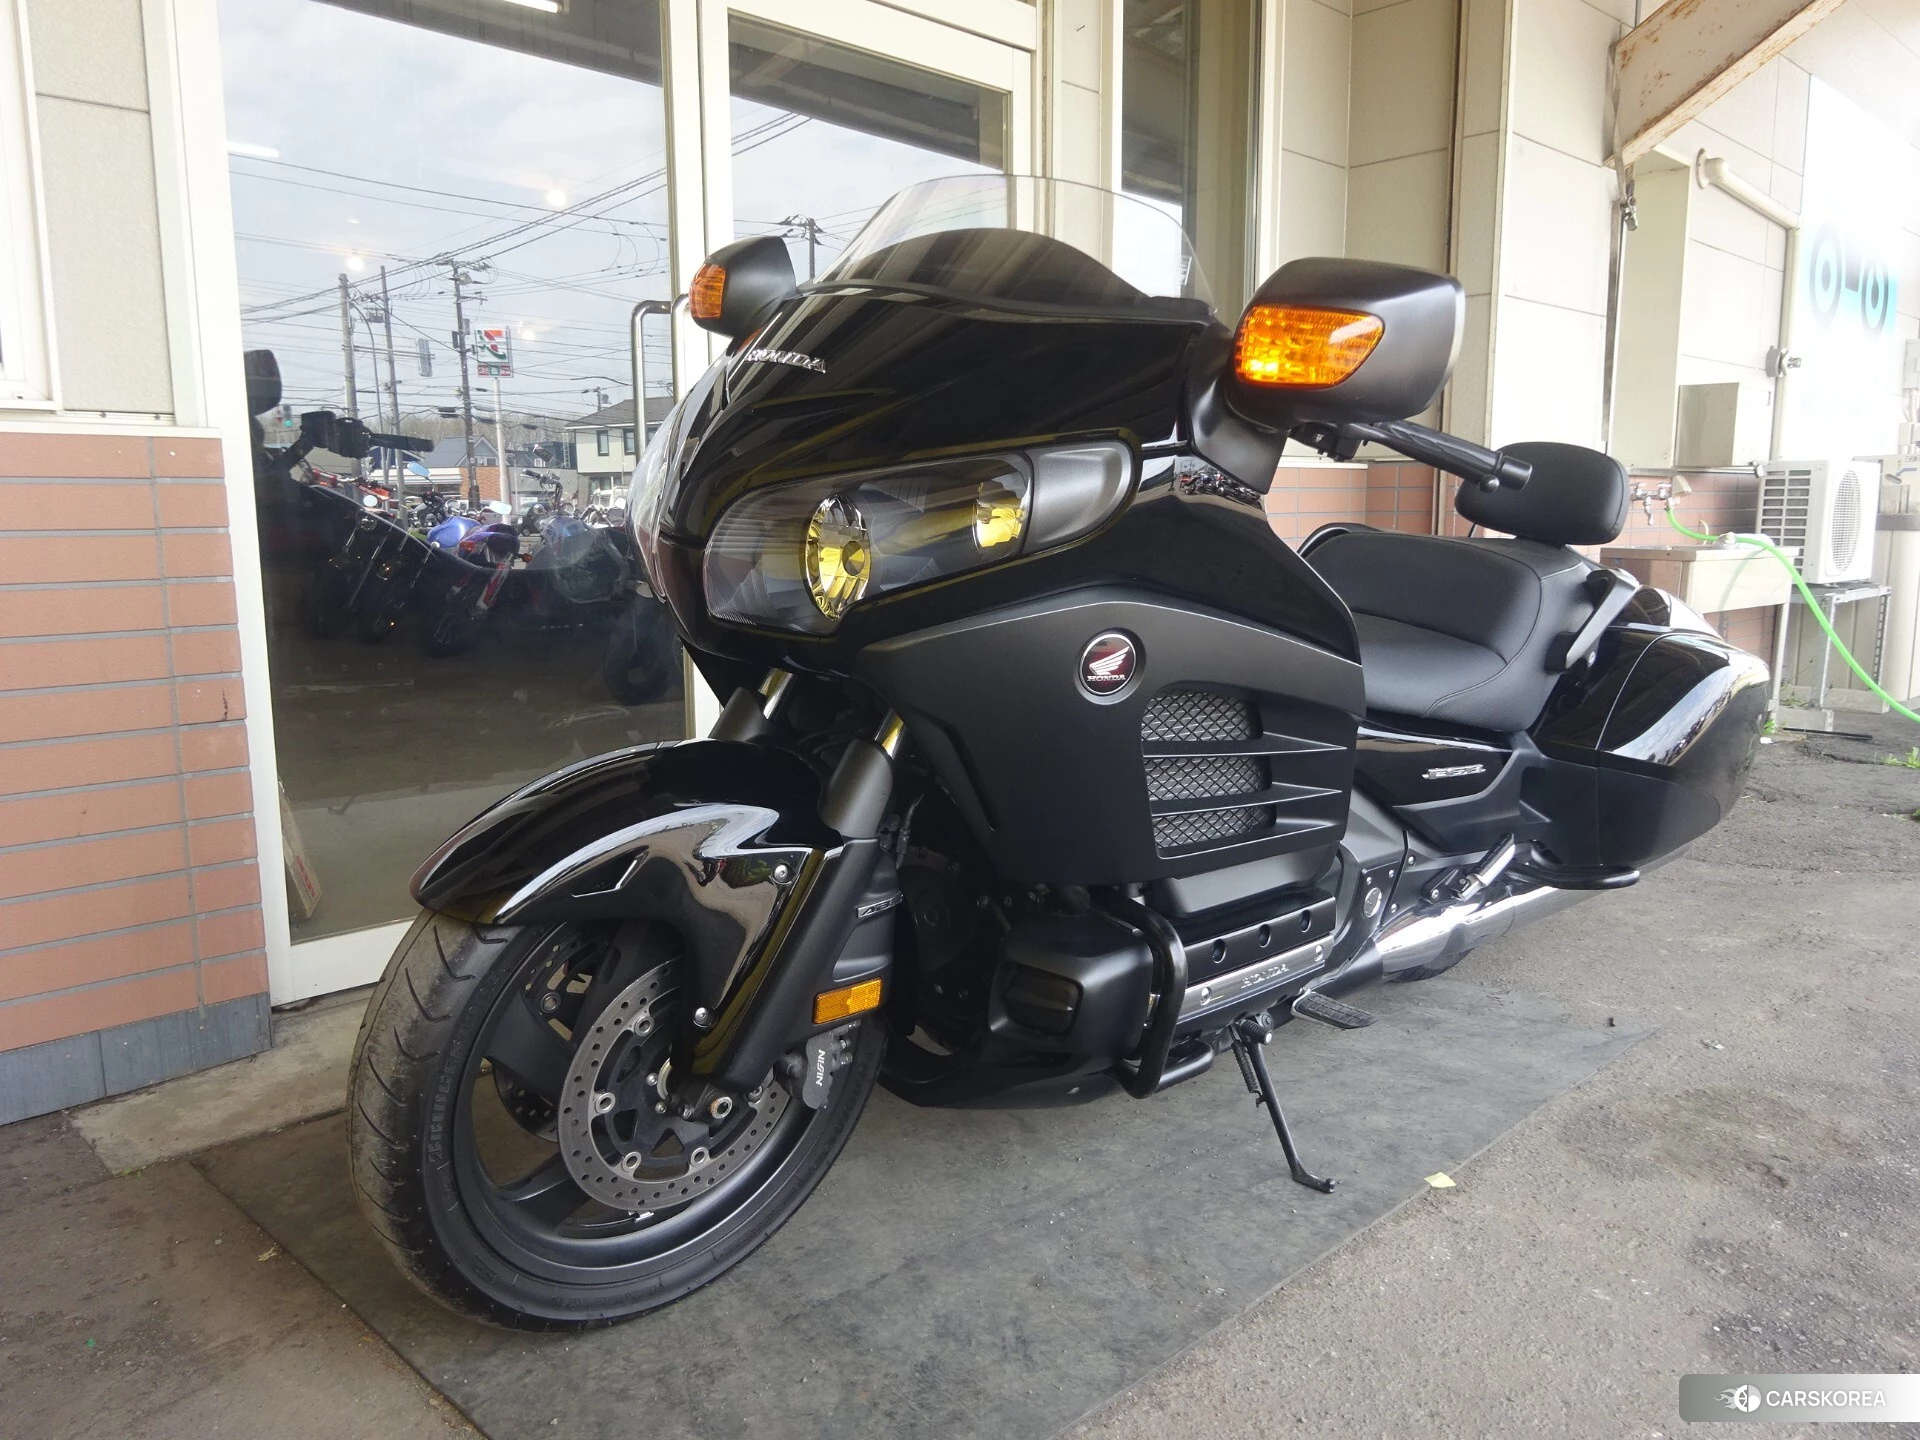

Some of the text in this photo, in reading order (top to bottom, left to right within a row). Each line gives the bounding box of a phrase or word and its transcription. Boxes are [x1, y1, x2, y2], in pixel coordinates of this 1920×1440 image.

[745, 349, 826, 374] HONDA
[1086, 674, 1127, 682] HONDA
[1241, 964, 1289, 989] HONDA
[815, 1049, 826, 1087] NISSIN
